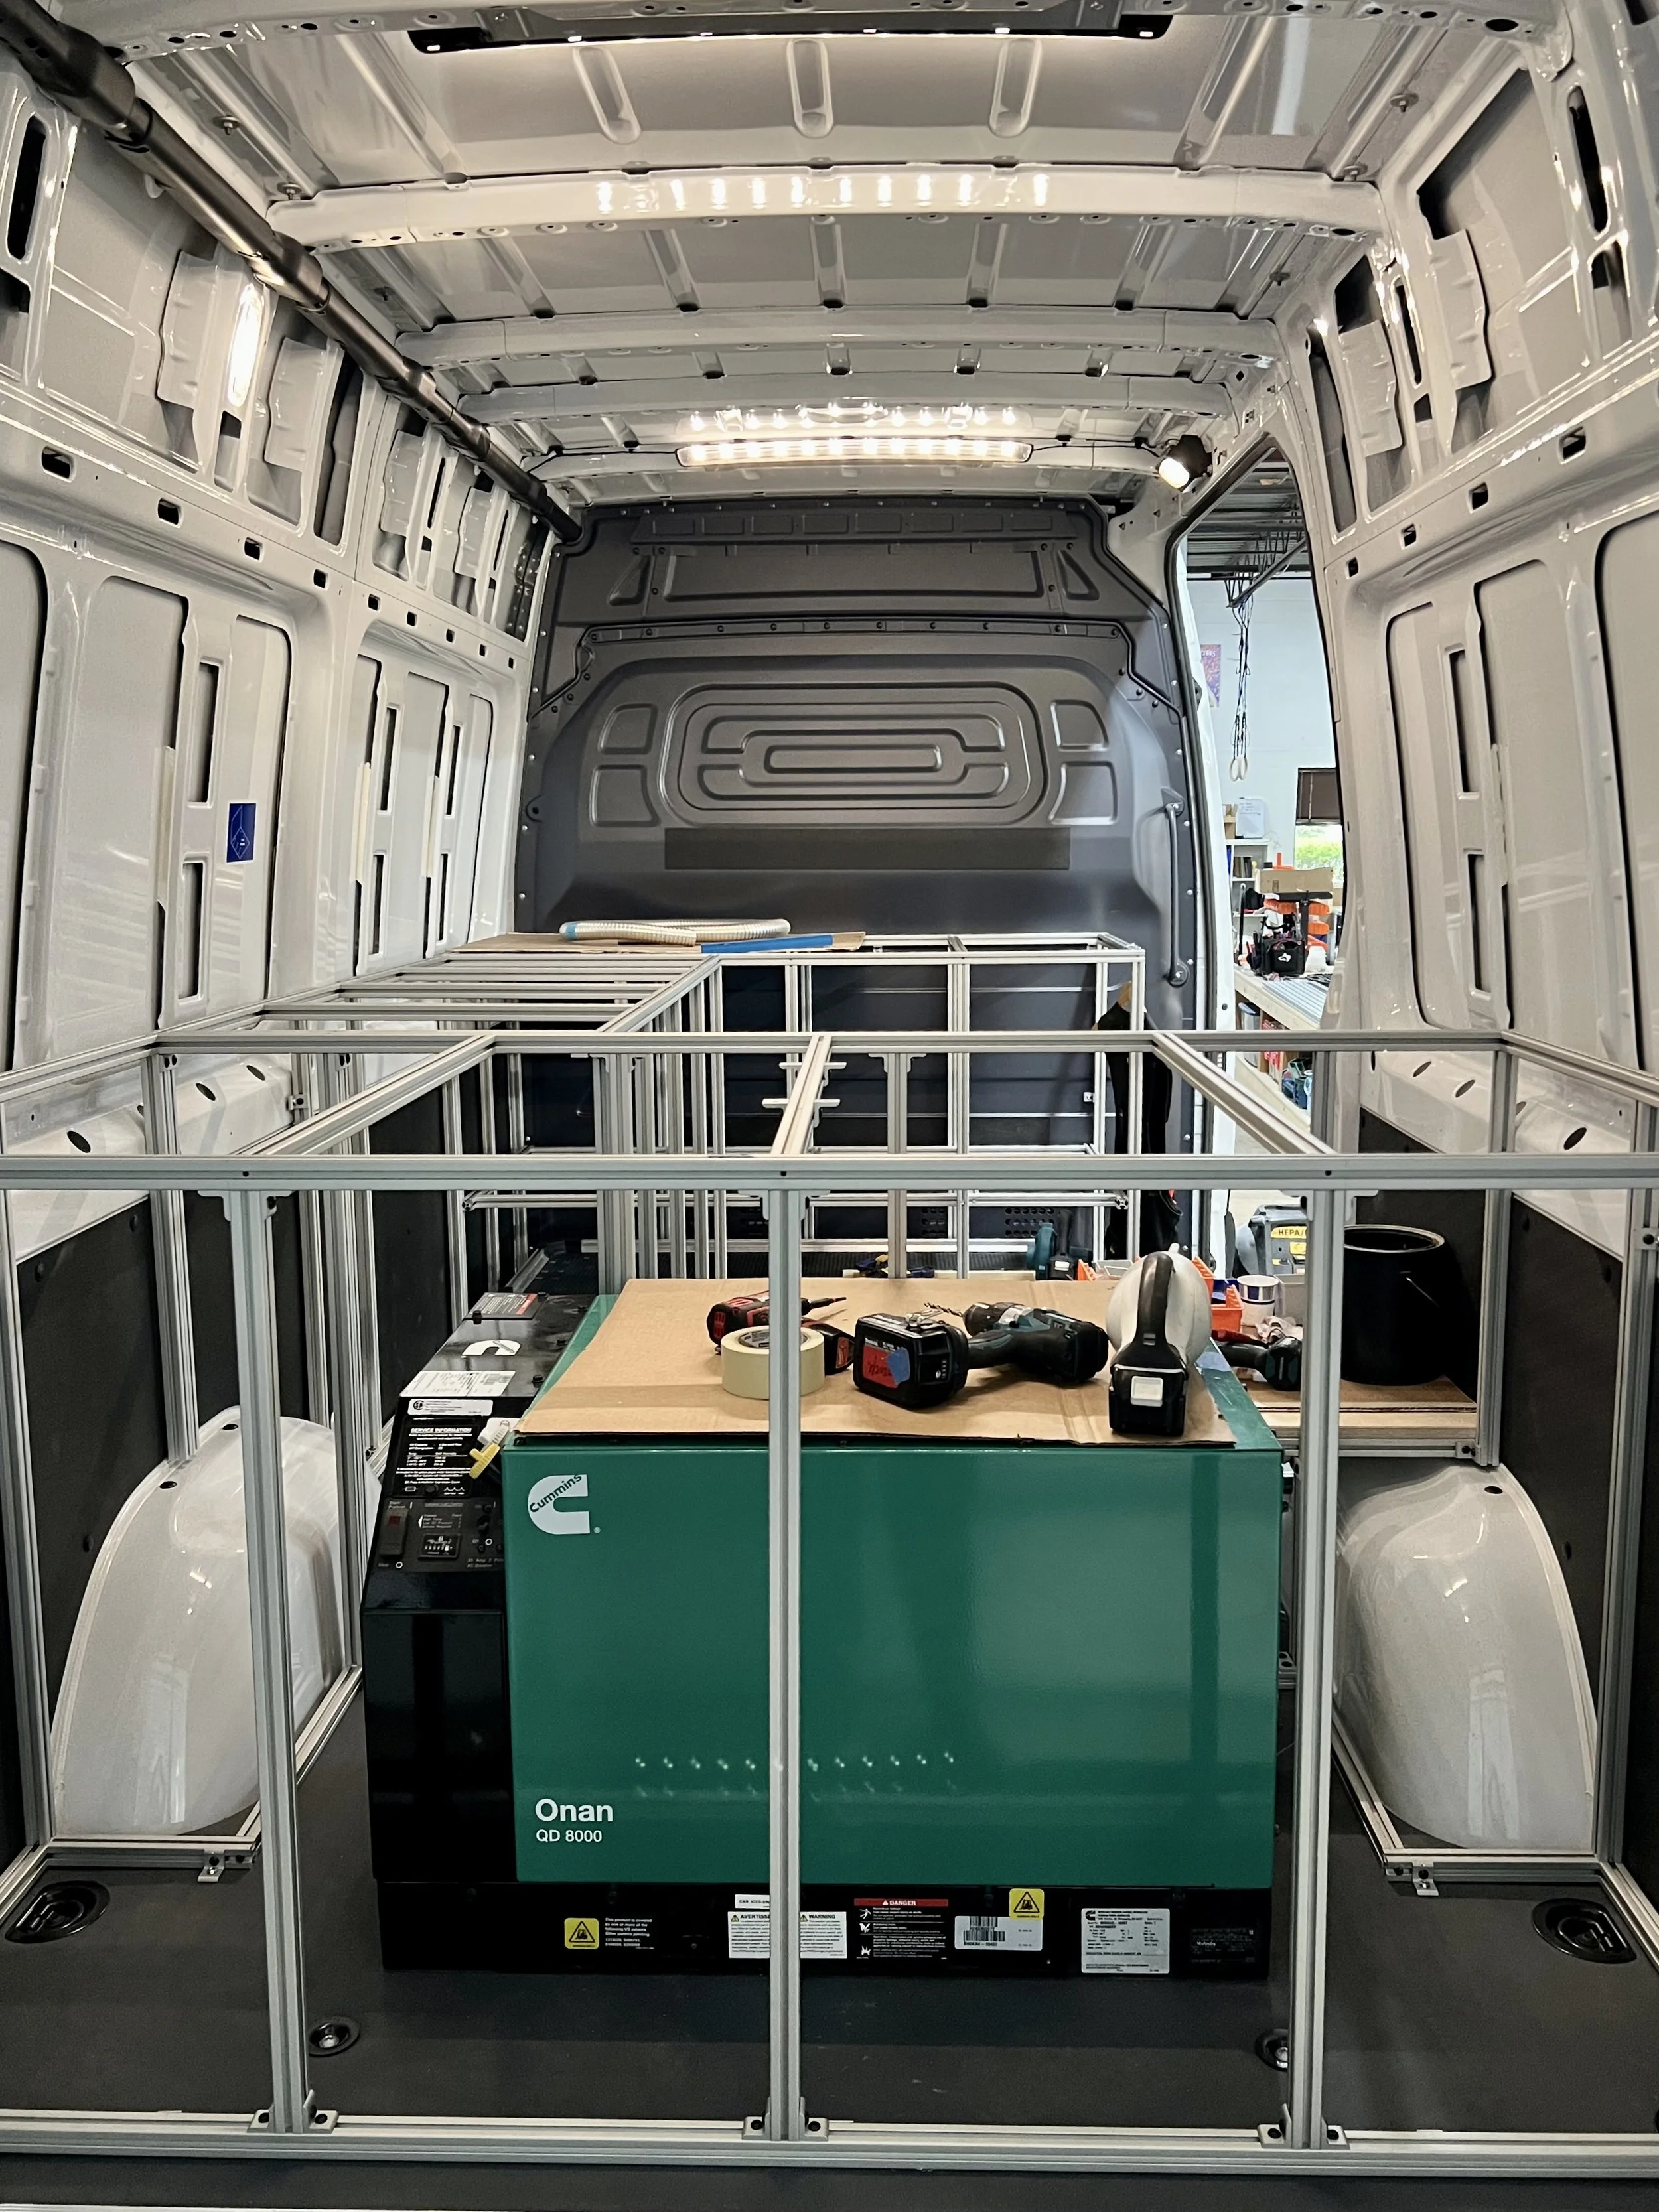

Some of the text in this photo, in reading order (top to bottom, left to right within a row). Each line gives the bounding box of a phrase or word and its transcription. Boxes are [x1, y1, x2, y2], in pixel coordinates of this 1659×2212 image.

[530, 1474, 582, 1513] Cummins
[535, 1798, 613, 1821] Onan
[536, 1829, 603, 1842] QD 8000
